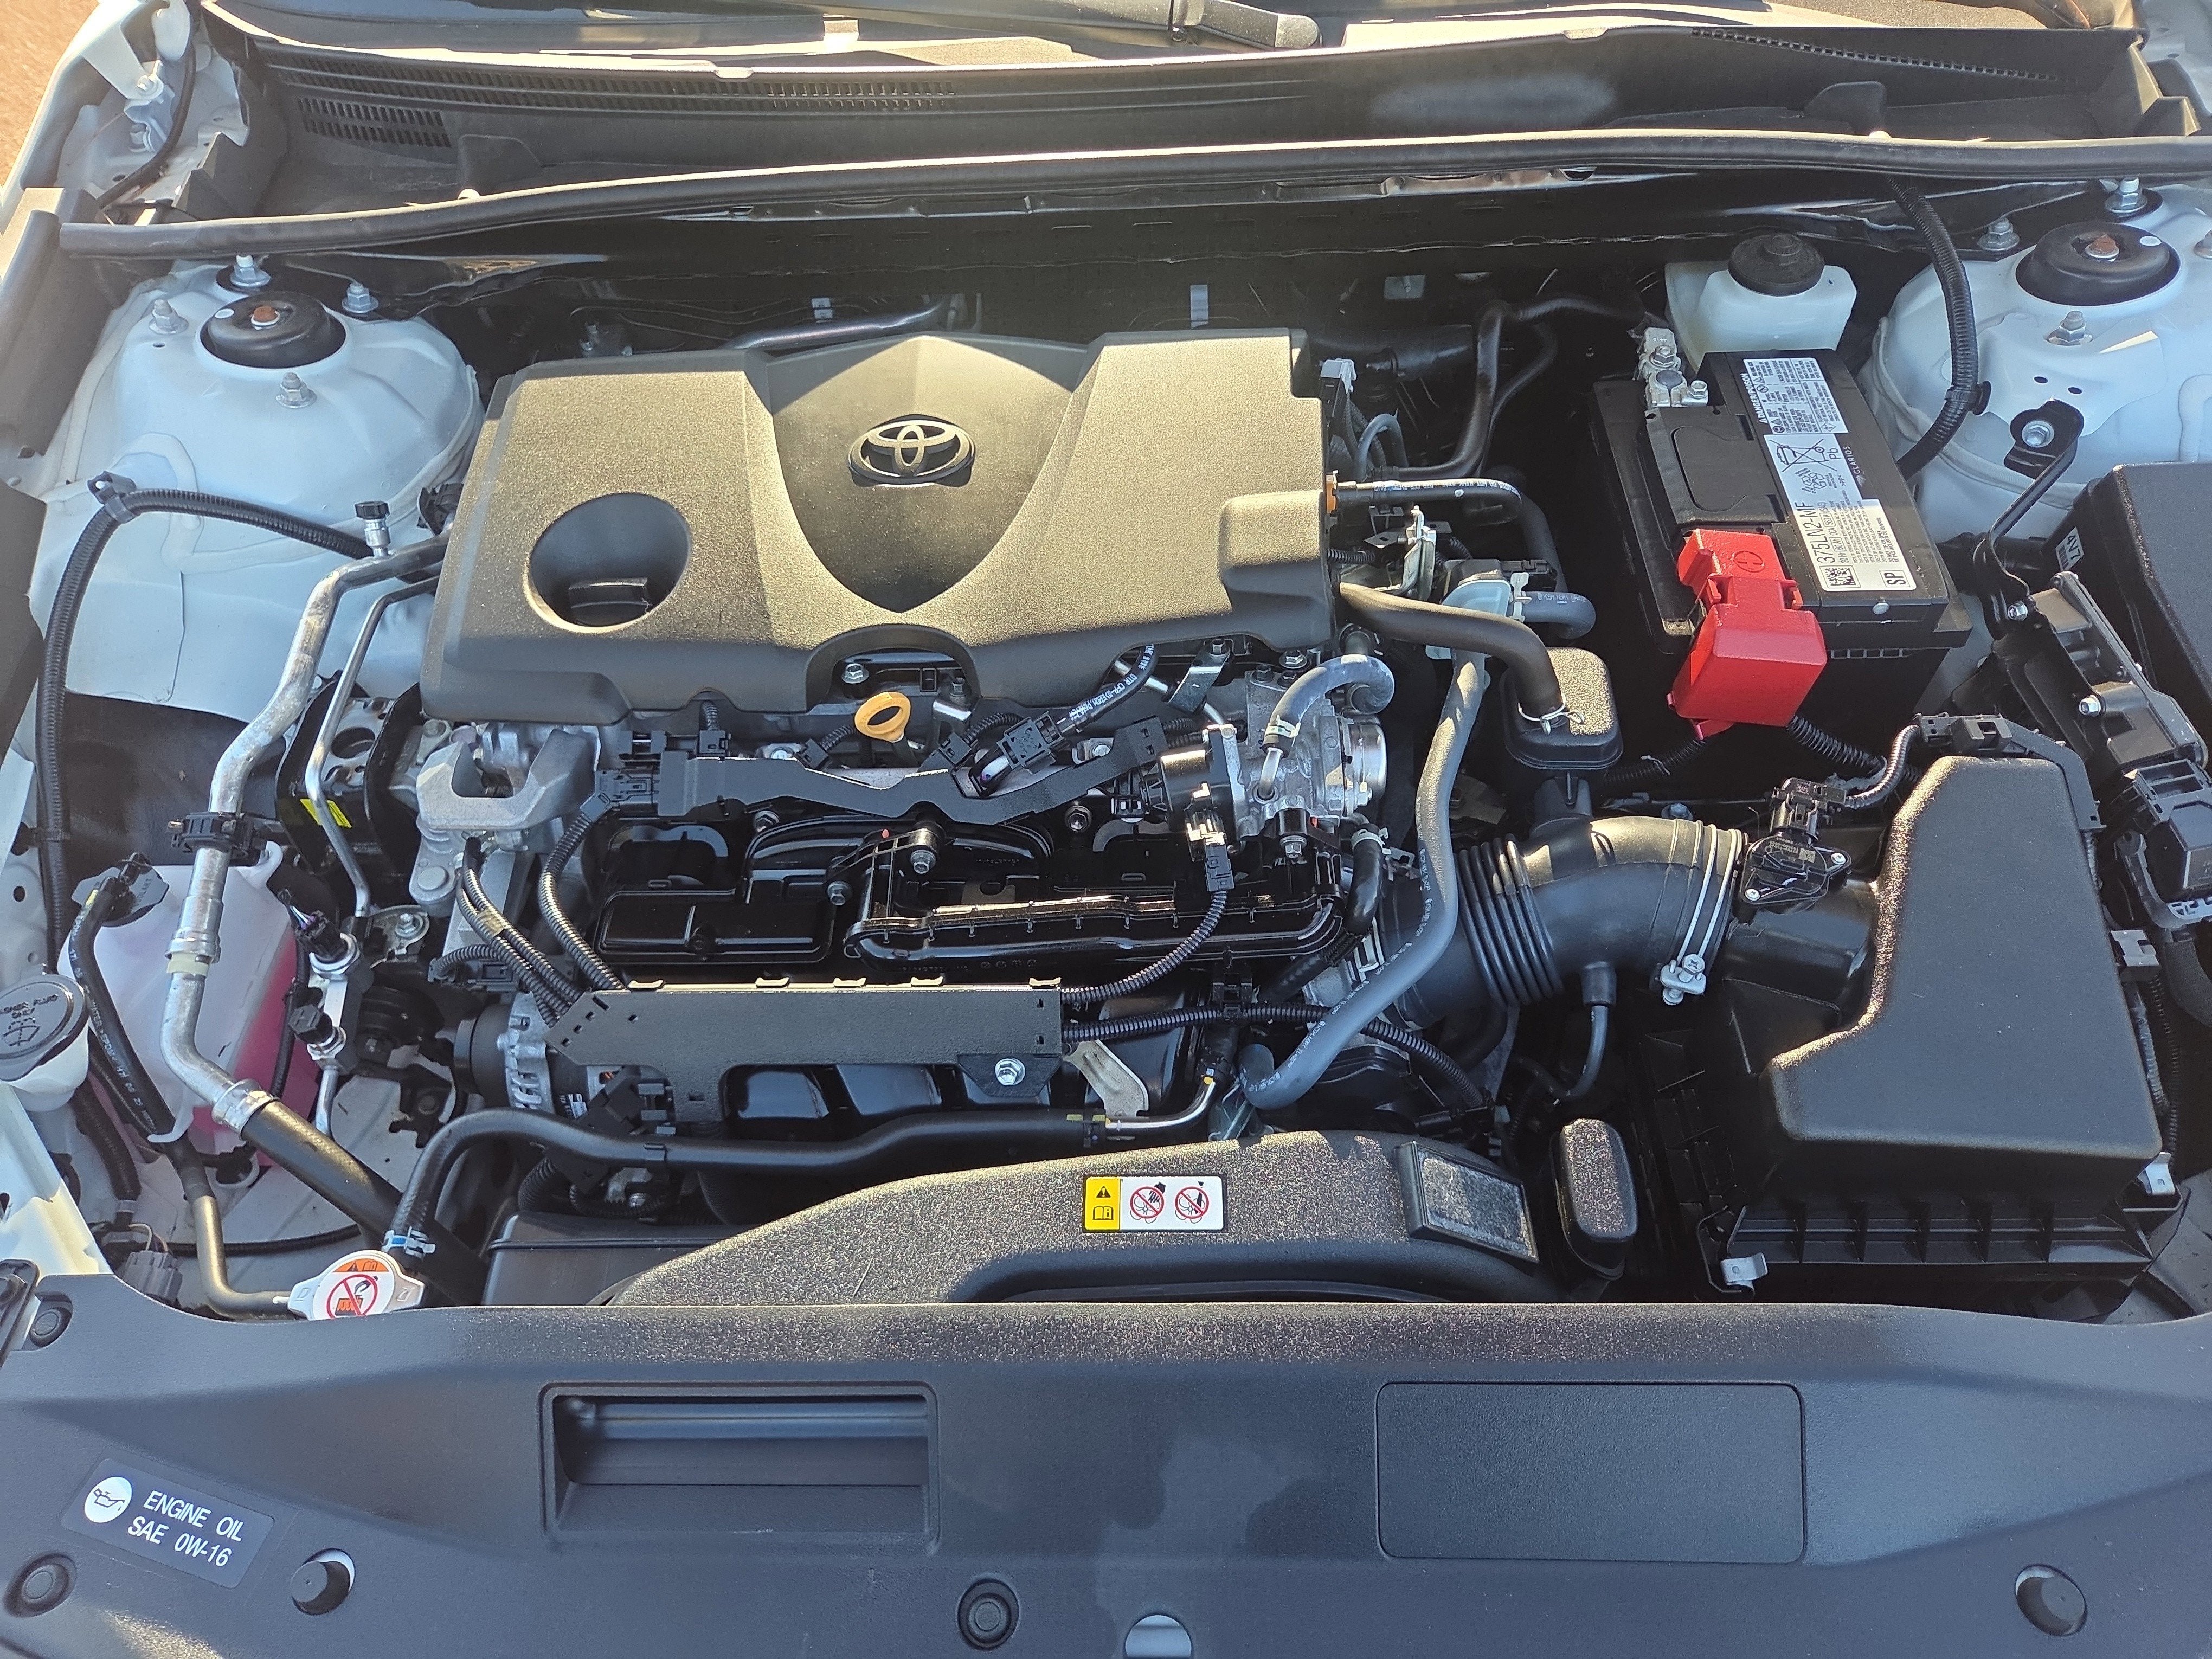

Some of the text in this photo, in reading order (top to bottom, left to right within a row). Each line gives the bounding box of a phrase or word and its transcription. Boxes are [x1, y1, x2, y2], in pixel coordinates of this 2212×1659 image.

[1740, 373, 1765, 418] DANGER/POISON
[1827, 448, 1842, 459] Pb
[1843, 446, 1860, 474] CLARIOS
[1795, 501, 1836, 563] 375LN2-MF
[2067, 535, 2081, 560] 4V7
[1884, 573, 1906, 584] SP
[143, 1490, 243, 1541] ENGINE OIL
[127, 1516, 232, 1567] SAE 0W-16
